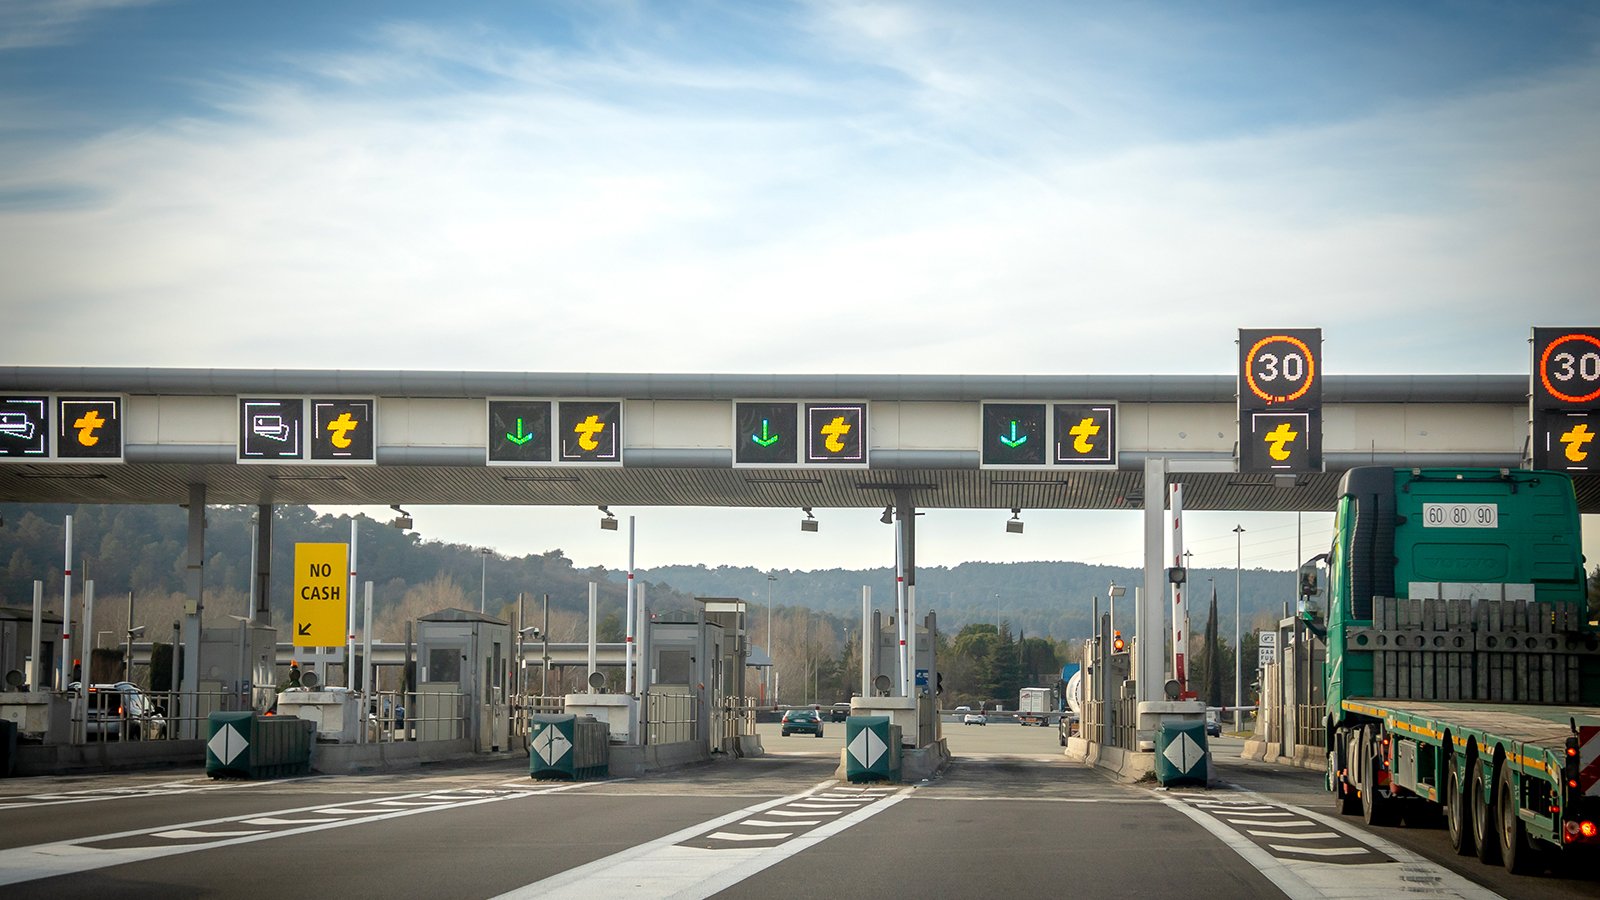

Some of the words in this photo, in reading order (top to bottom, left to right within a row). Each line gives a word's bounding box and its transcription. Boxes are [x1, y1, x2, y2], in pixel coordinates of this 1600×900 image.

[1258, 353, 1303, 381] 30
[1554, 352, 1600, 381] 30
[74, 410, 105, 447] t
[327, 412, 358, 448] t
[574, 415, 604, 450] t
[820, 416, 850, 452] t
[1069, 418, 1100, 454] t
[1264, 423, 1298, 461] t
[1559, 424, 1596, 461] t
[1429, 507, 1443, 523] 60
[1453, 508, 1467, 523] 80
[1477, 508, 1491, 523] 90
[310, 563, 332, 577] NO
[301, 586, 340, 600] CASH
